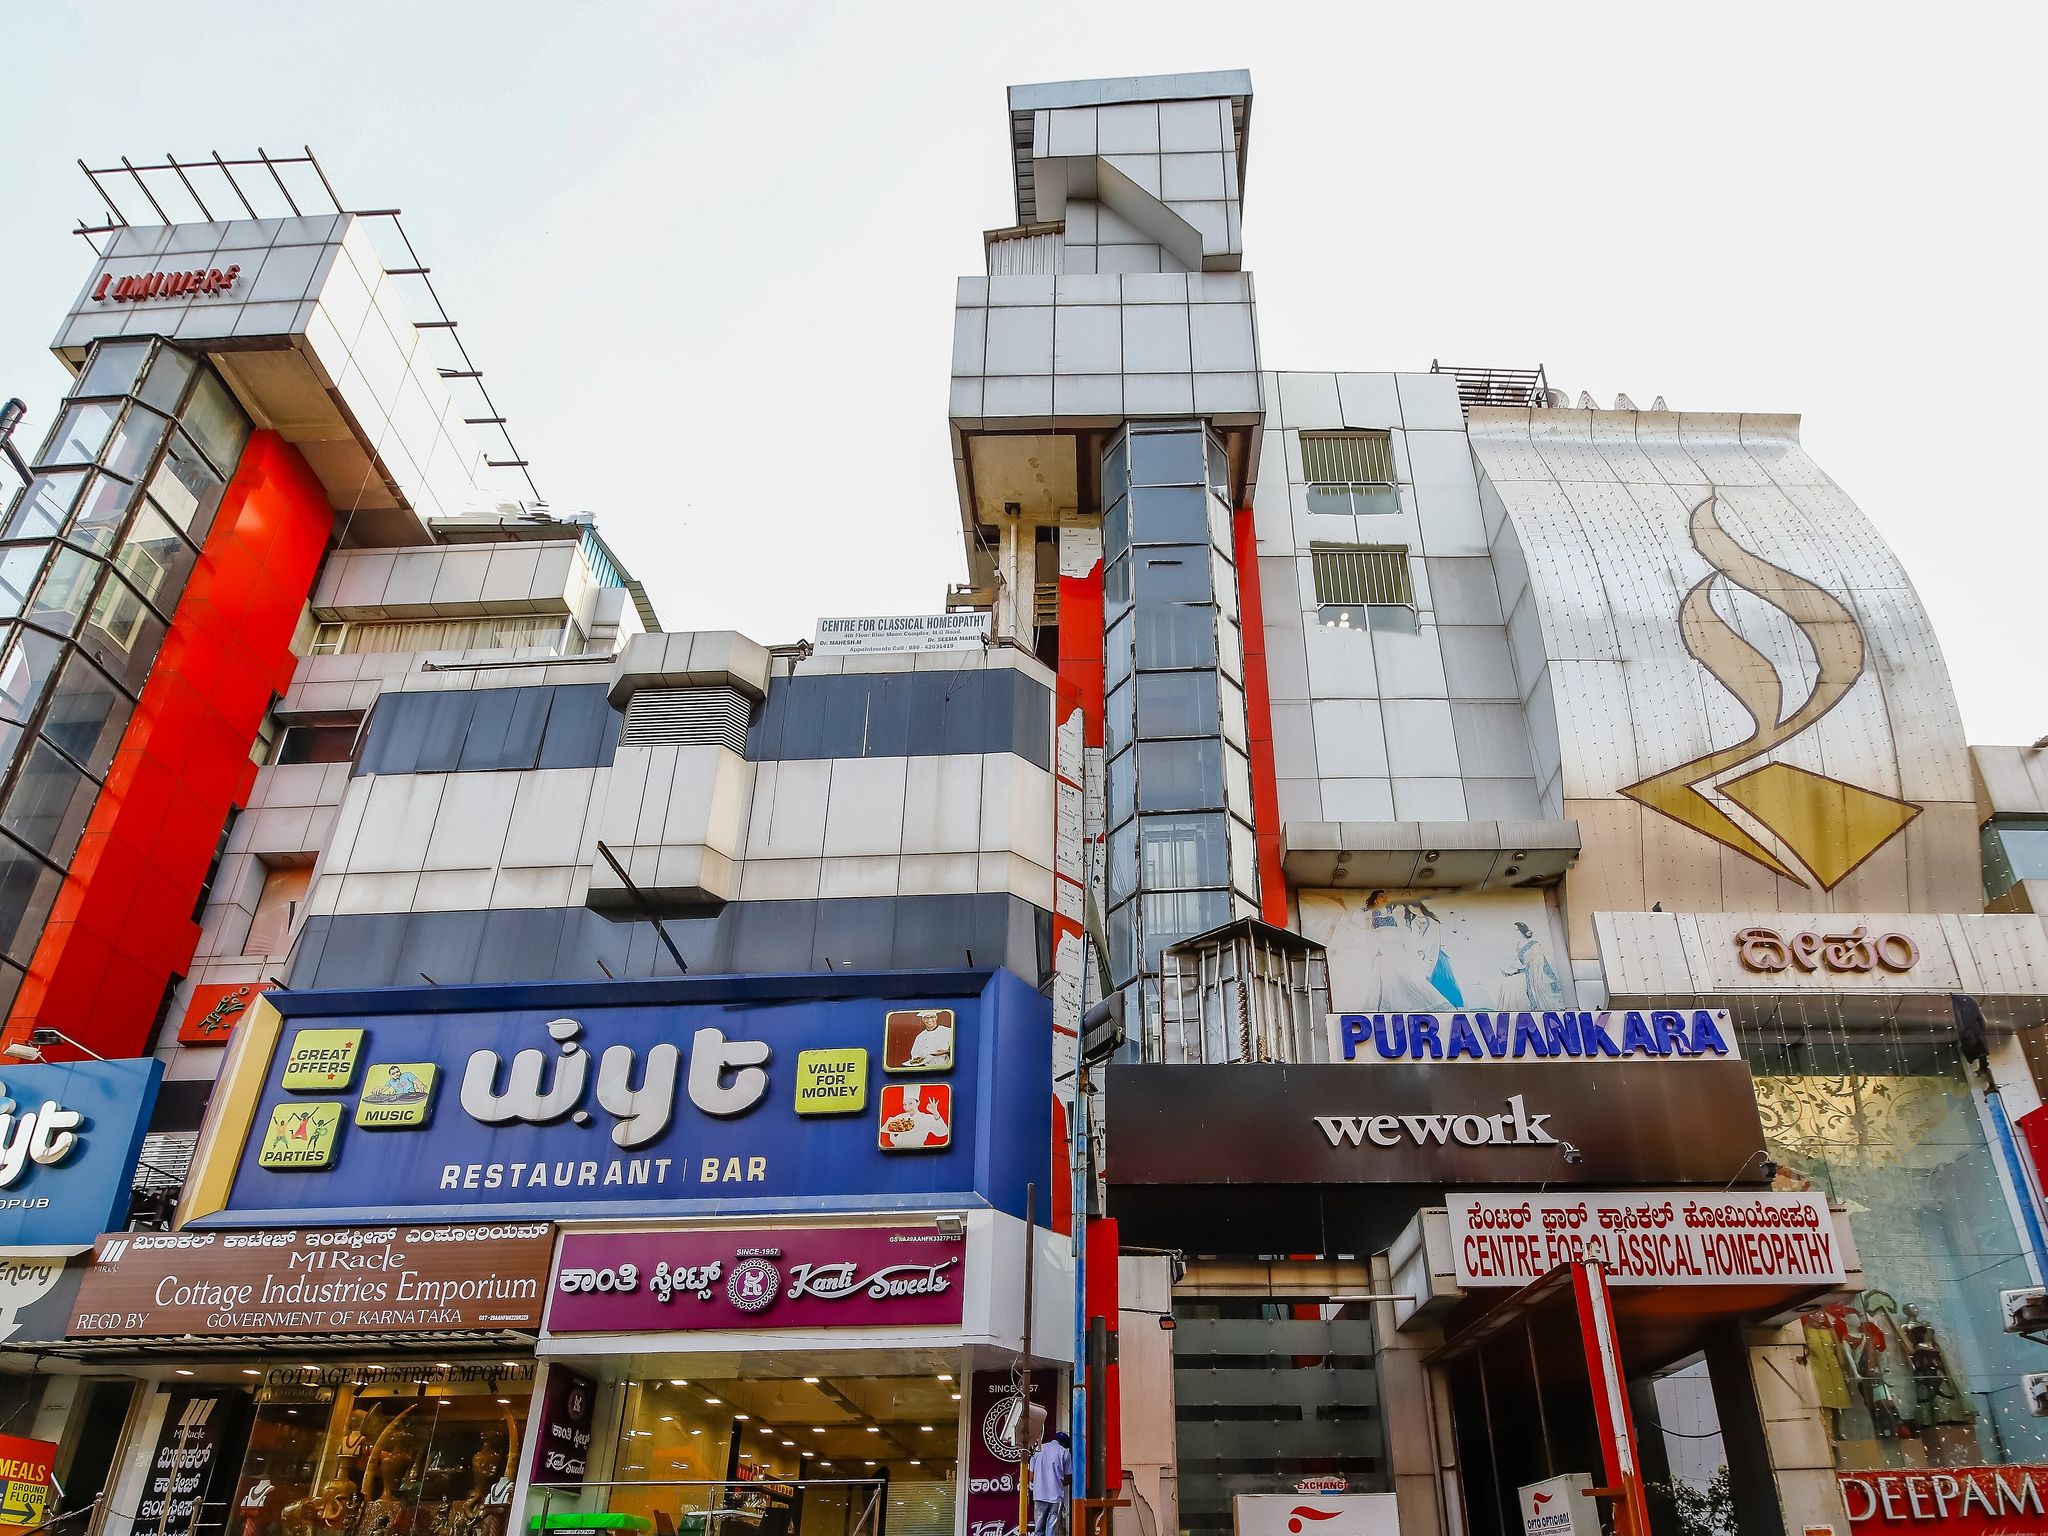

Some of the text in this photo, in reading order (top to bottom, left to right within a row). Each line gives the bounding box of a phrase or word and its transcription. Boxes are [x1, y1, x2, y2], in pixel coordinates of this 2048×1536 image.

[822, 615, 985, 632] CENTRE FOR CLASSICAL HOMEOPATHY
[1735, 925, 1920, 973] ದೀಪಂ
[1340, 1011, 1729, 1060] PURAVANKARA
[297, 1049, 350, 1061] GREAT
[288, 1062, 350, 1074] OFFERS
[808, 1063, 855, 1074] VALUE
[816, 1075, 845, 1086] FOR
[802, 1086, 858, 1098] MONEY
[365, 1110, 414, 1121] MUSIC
[1314, 1094, 1559, 1147] wework
[264, 1151, 324, 1162] PARTIES
[440, 1156, 767, 1189] RESTAURANT BAR
[1467, 1201, 1532, 1230] ಸೆಂಟರ್
[1541, 1201, 1588, 1234] ಫಾರ್
[1597, 1200, 1675, 1233] ಕ್ಲಾಸಿಕಲ್
[132, 1232, 216, 1249] ಮಿರಾಕಲ್
[223, 1231, 297, 1247] ಕಾಟೇಜ್
[736, 1248, 779, 1256] SINCE-1957
[1463, 1234, 1545, 1278] CENTRE
[1701, 1233, 1834, 1276] HOMEOPATHY
[559, 1260, 722, 1303] ಕಾಂತಿ ಸ್ವೀಟ್ಸ್
[787, 1262, 951, 1299] Kanti Sweets
[155, 1270, 537, 1312] Cottage Industries Emporium
[76, 1312, 150, 1329] REGD BY
[207, 1309, 462, 1328] GOVERNMENT OF KARNATAKA
[268, 1364, 536, 1385] COTTAGE INDUSTRIES EMPORIUM
[0, 1458, 46, 1482] MEALS
[9, 1491, 44, 1504] FLOOR
[12, 1483, 46, 1494] GROUND
[1837, 1471, 2046, 1521] DEEPAM
